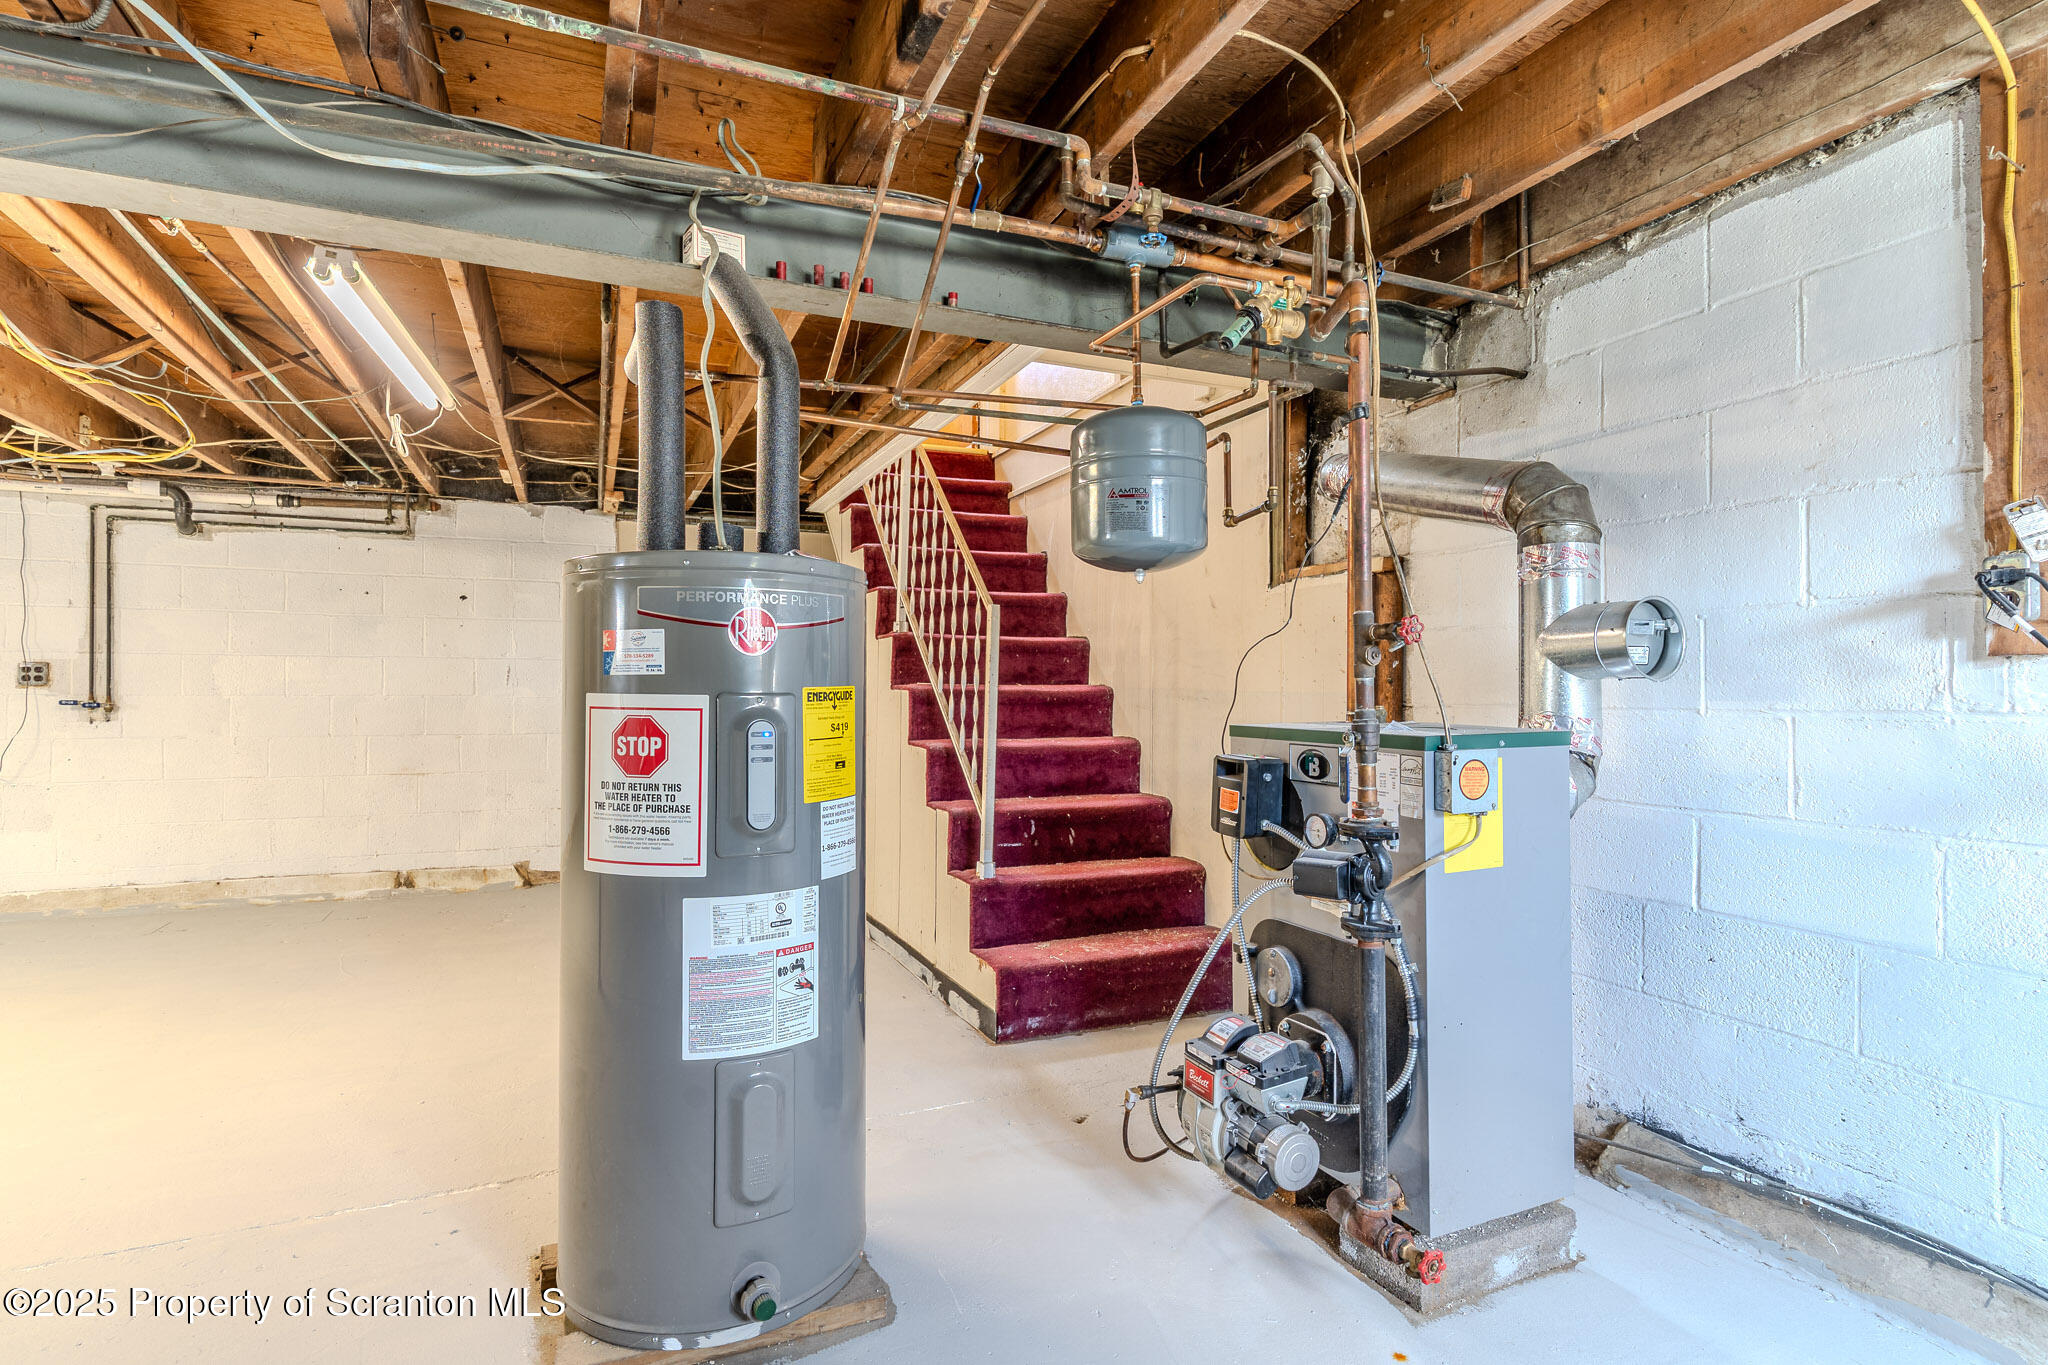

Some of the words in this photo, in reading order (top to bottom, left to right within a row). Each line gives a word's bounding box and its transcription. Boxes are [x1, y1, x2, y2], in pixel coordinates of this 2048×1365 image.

[676, 590, 788, 605] PERFORMANCE
[791, 595, 820, 608] PLUS
[734, 616, 777, 648] Rheem
[806, 690, 853, 702] ENERGYGUIDE
[616, 735, 662, 757] STOP
[600, 781, 610, 790] DO
[611, 781, 625, 791] NOT
[628, 782, 660, 792] RETURN
[663, 783, 682, 792] THIS
[604, 791, 629, 802] WATER
[631, 792, 662, 803] HEATER
[665, 793, 676, 803] TO
[594, 801, 606, 811] THE
[607, 802, 631, 813] PLACE
[633, 803, 643, 813] OF
[645, 803, 691, 814] PURCHASE
[608, 824, 671, 836] 1-866-279-4566
[785, 944, 813, 955] DANGER
[1189, 1069, 1209, 1088] Beckett
